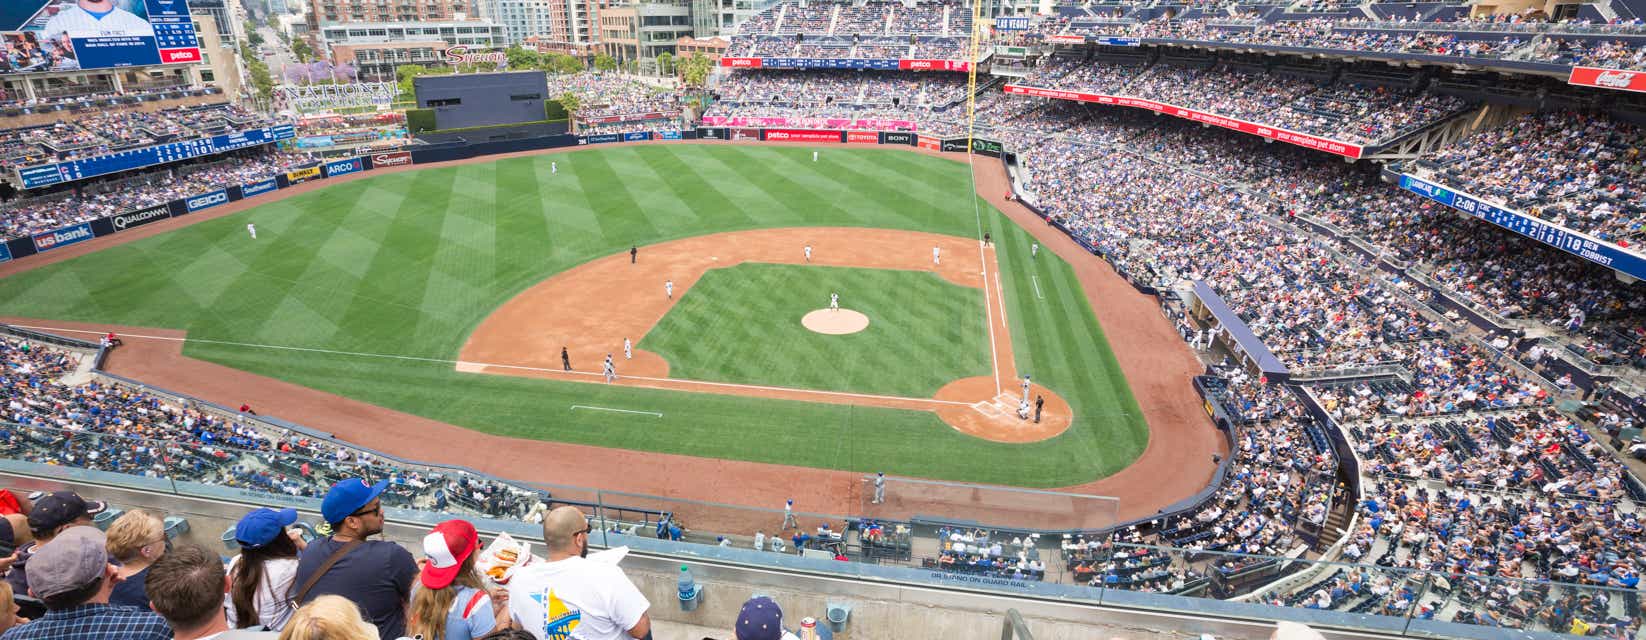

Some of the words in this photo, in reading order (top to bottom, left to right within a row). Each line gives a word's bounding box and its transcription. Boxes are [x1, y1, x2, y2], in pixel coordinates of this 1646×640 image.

[997, 20, 1008, 28] LAS
[1009, 20, 1028, 29] VEGAS
[170, 51, 193, 61] petco
[768, 132, 789, 140] petco
[1257, 127, 1273, 137] petco
[1277, 132, 1290, 141] your
[1290, 134, 1317, 147] complete
[1317, 140, 1328, 150] pet
[1328, 142, 1346, 153] store
[195, 147, 200, 155] 1
[201, 145, 207, 154] 0
[208, 144, 213, 153] 1
[329, 163, 353, 173] ARCO
[189, 192, 226, 209] GEICO
[1455, 196, 1476, 212] 2:06
[114, 207, 168, 229] QUALCOMM
[1529, 227, 1537, 237] 2
[1540, 231, 1545, 240] 1
[1546, 233, 1554, 243] 0
[1556, 237, 1561, 246] 1
[1567, 236, 1582, 251] 18
[1583, 240, 1599, 252] BEN
[1580, 247, 1613, 266] ZOBRIST
[943, 574, 968, 582] STAND
[969, 576, 981, 584] ON
[982, 578, 1009, 587] GUARD
[1010, 581, 1027, 589] RAIL
